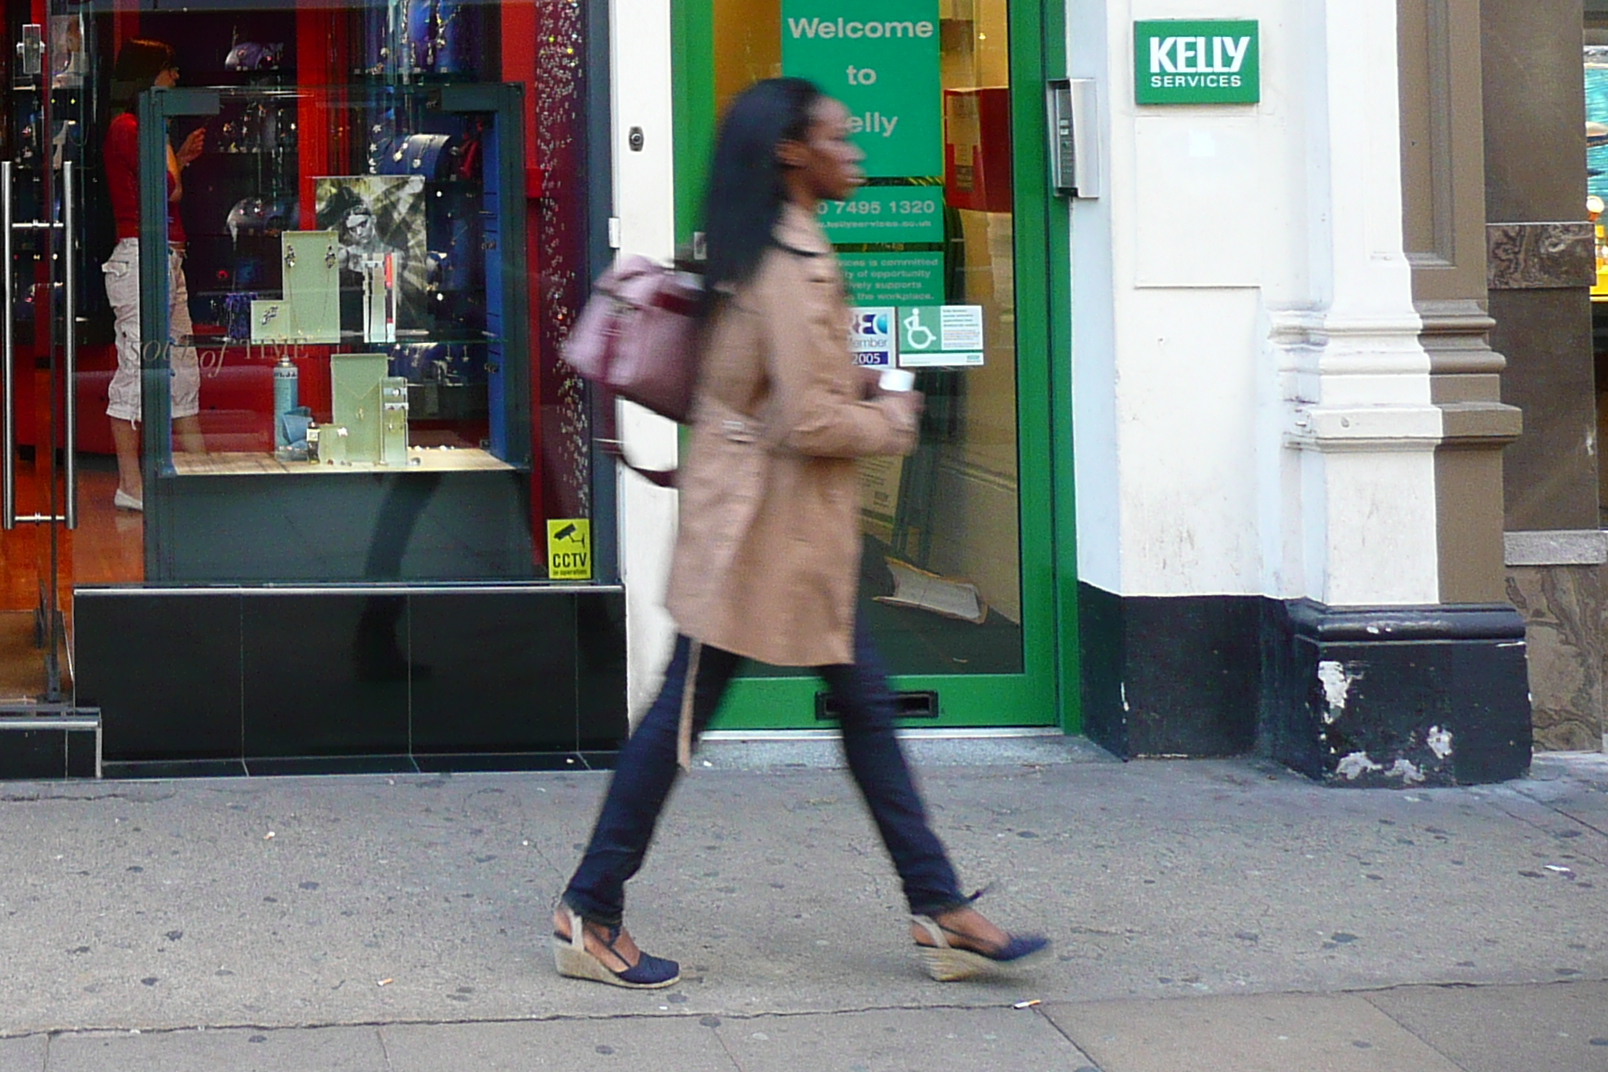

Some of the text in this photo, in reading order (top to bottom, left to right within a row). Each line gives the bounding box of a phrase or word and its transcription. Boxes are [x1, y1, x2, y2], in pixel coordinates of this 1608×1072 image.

[787, 17, 934, 39] Welcome
[1149, 36, 1251, 73] KELLY
[846, 65, 877, 85] to
[1150, 75, 1242, 87] SERVICES
[845, 111, 899, 137] elly
[834, 200, 881, 215] 7495
[889, 200, 936, 214] 1320
[200, 341, 229, 378] of
[242, 337, 309, 359] TIME
[852, 352, 881, 364] 2005
[553, 552, 587, 568] CCTV
